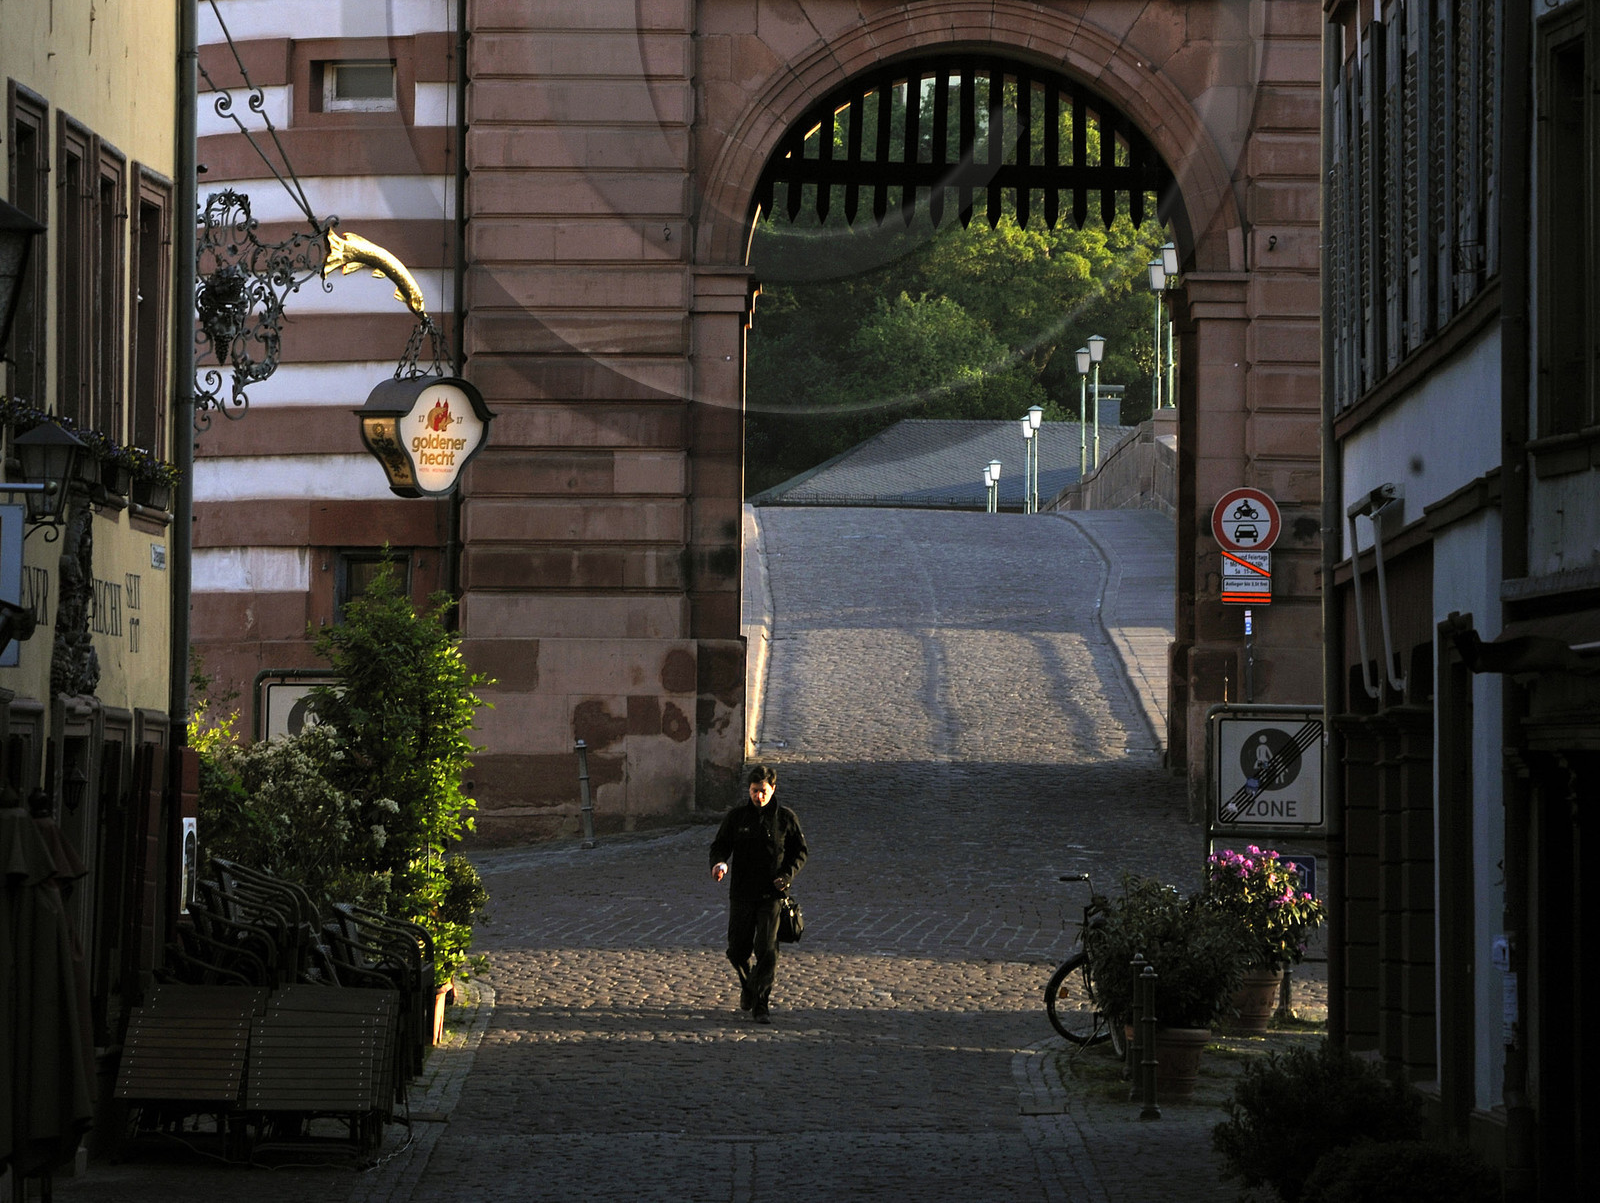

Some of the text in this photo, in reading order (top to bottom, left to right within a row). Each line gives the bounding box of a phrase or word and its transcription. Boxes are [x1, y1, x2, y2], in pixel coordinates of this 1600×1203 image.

[418, 415, 463, 424] 17 17
[412, 434, 466, 452] goldener
[419, 450, 455, 466] hecht
[125, 572, 140, 610] SEIT
[91, 578, 122, 637] HECHT
[1246, 800, 1296, 817] ZONE
